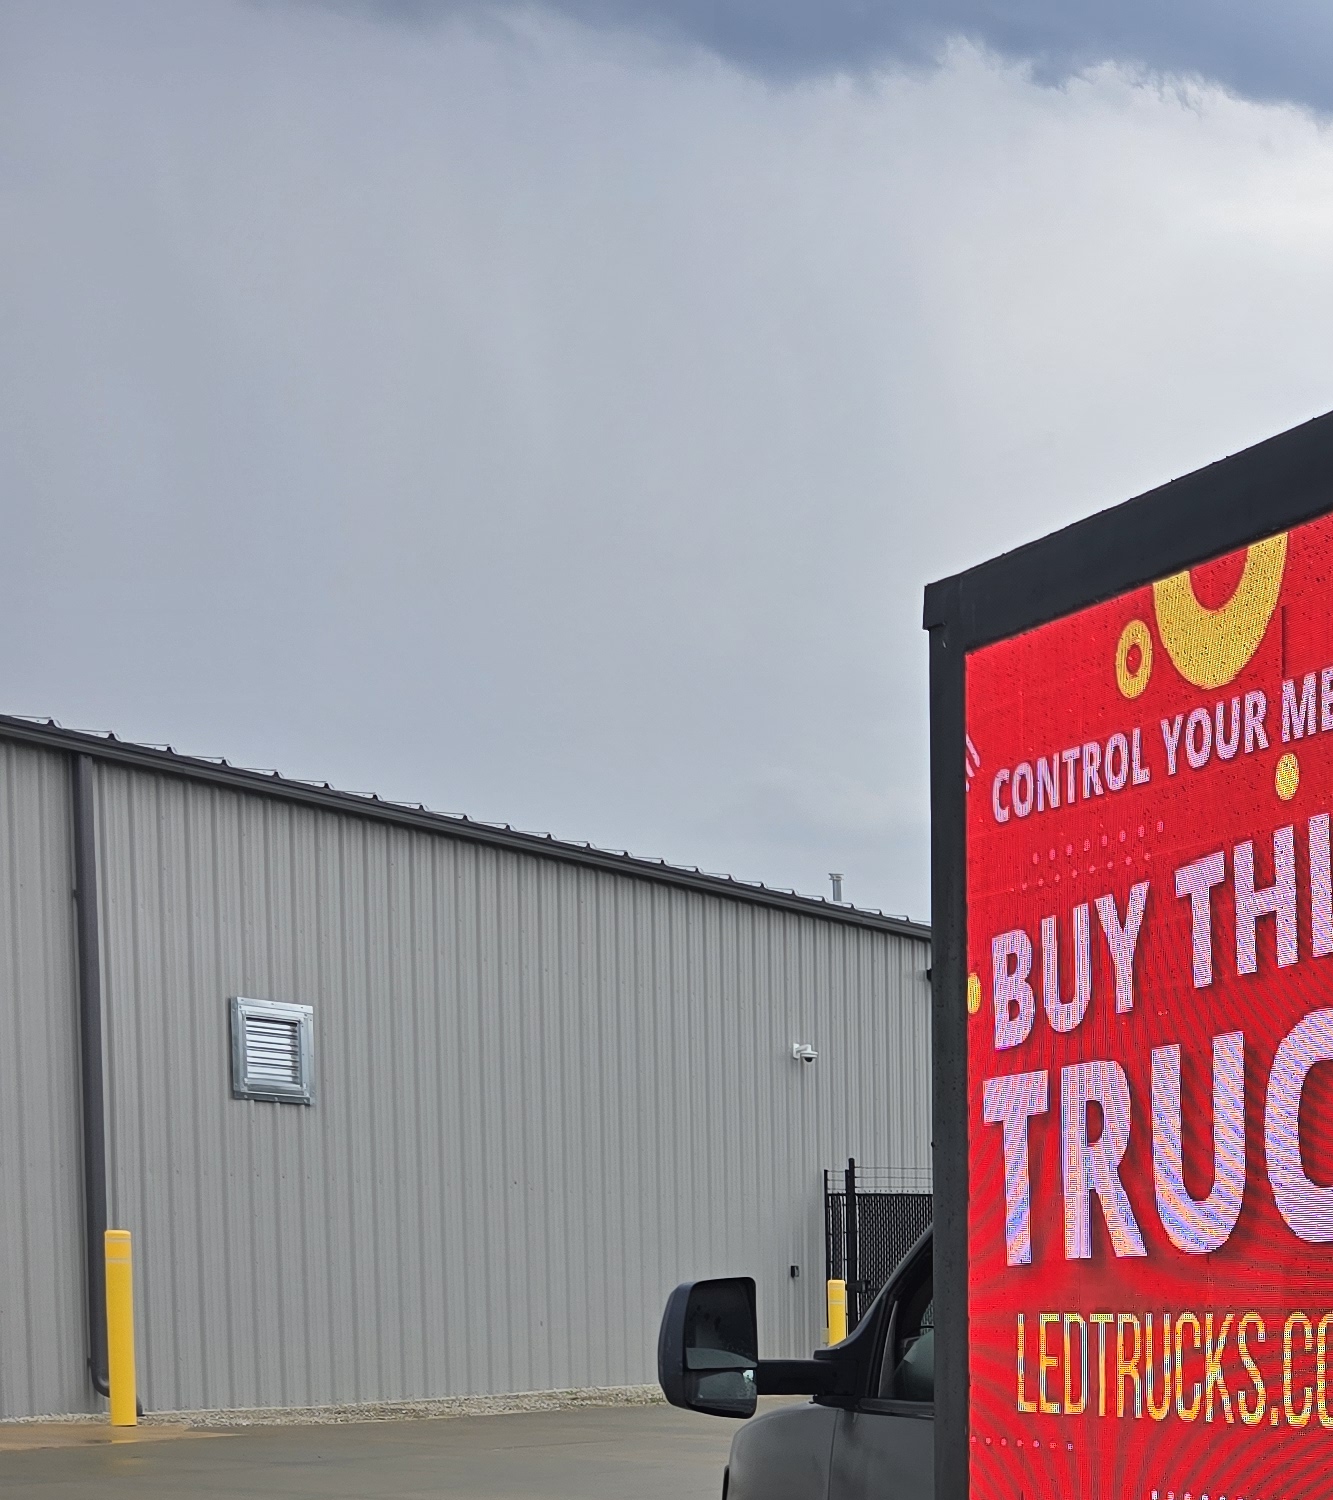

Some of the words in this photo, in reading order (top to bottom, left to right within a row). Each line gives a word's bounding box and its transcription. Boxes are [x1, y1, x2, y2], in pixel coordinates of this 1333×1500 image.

[991, 731, 1150, 822] CONTROL
[1160, 690, 1270, 776] YOUR
[991, 881, 1151, 1051] BUY
